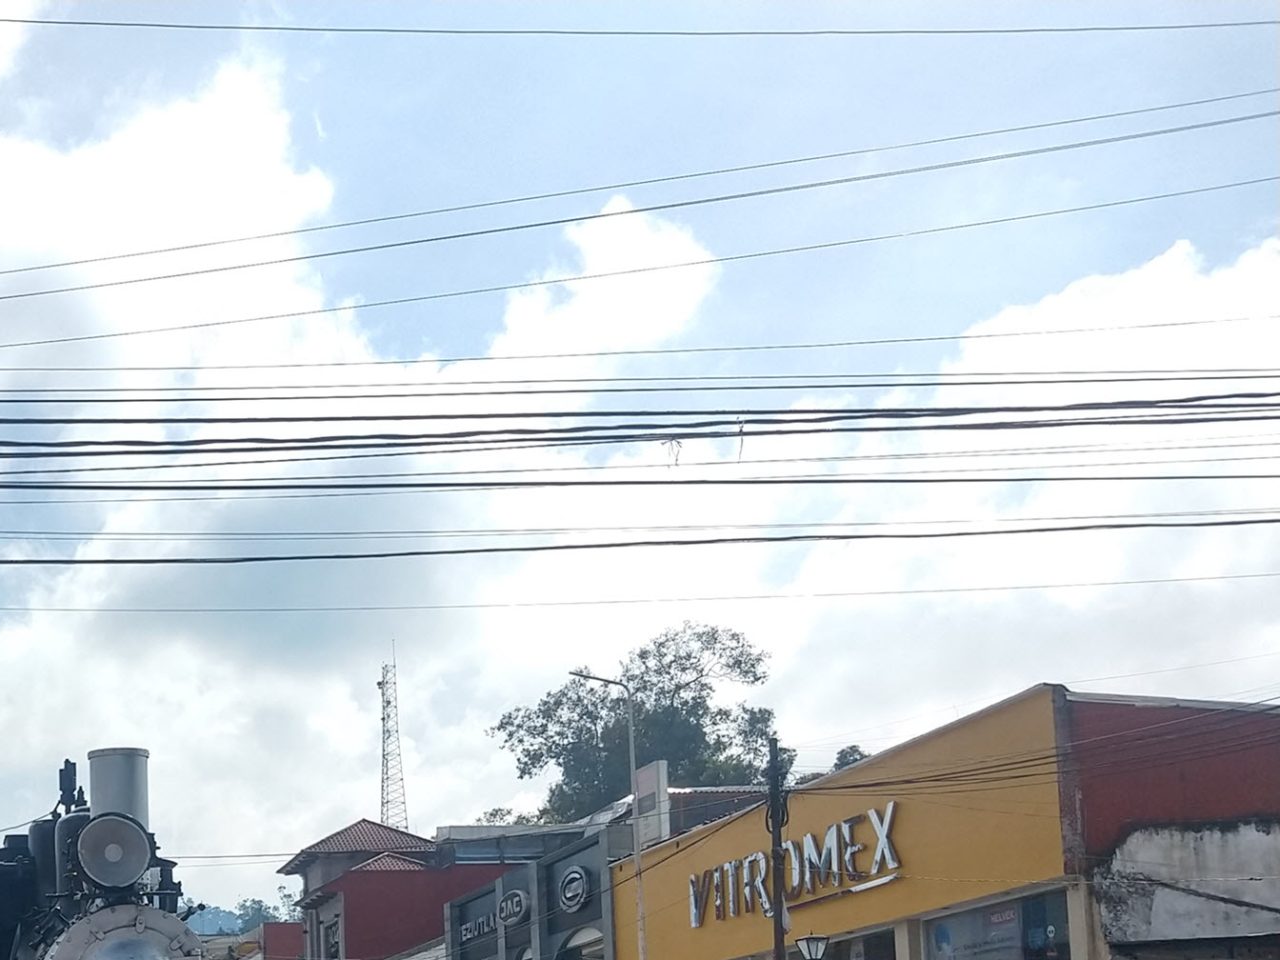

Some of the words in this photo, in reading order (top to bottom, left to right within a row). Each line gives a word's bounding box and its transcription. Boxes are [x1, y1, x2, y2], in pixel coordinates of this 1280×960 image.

[688, 800, 901, 929] VITROMEX
[500, 896, 521, 918] JAC
[461, 913, 497, 941] EZIUTLA
